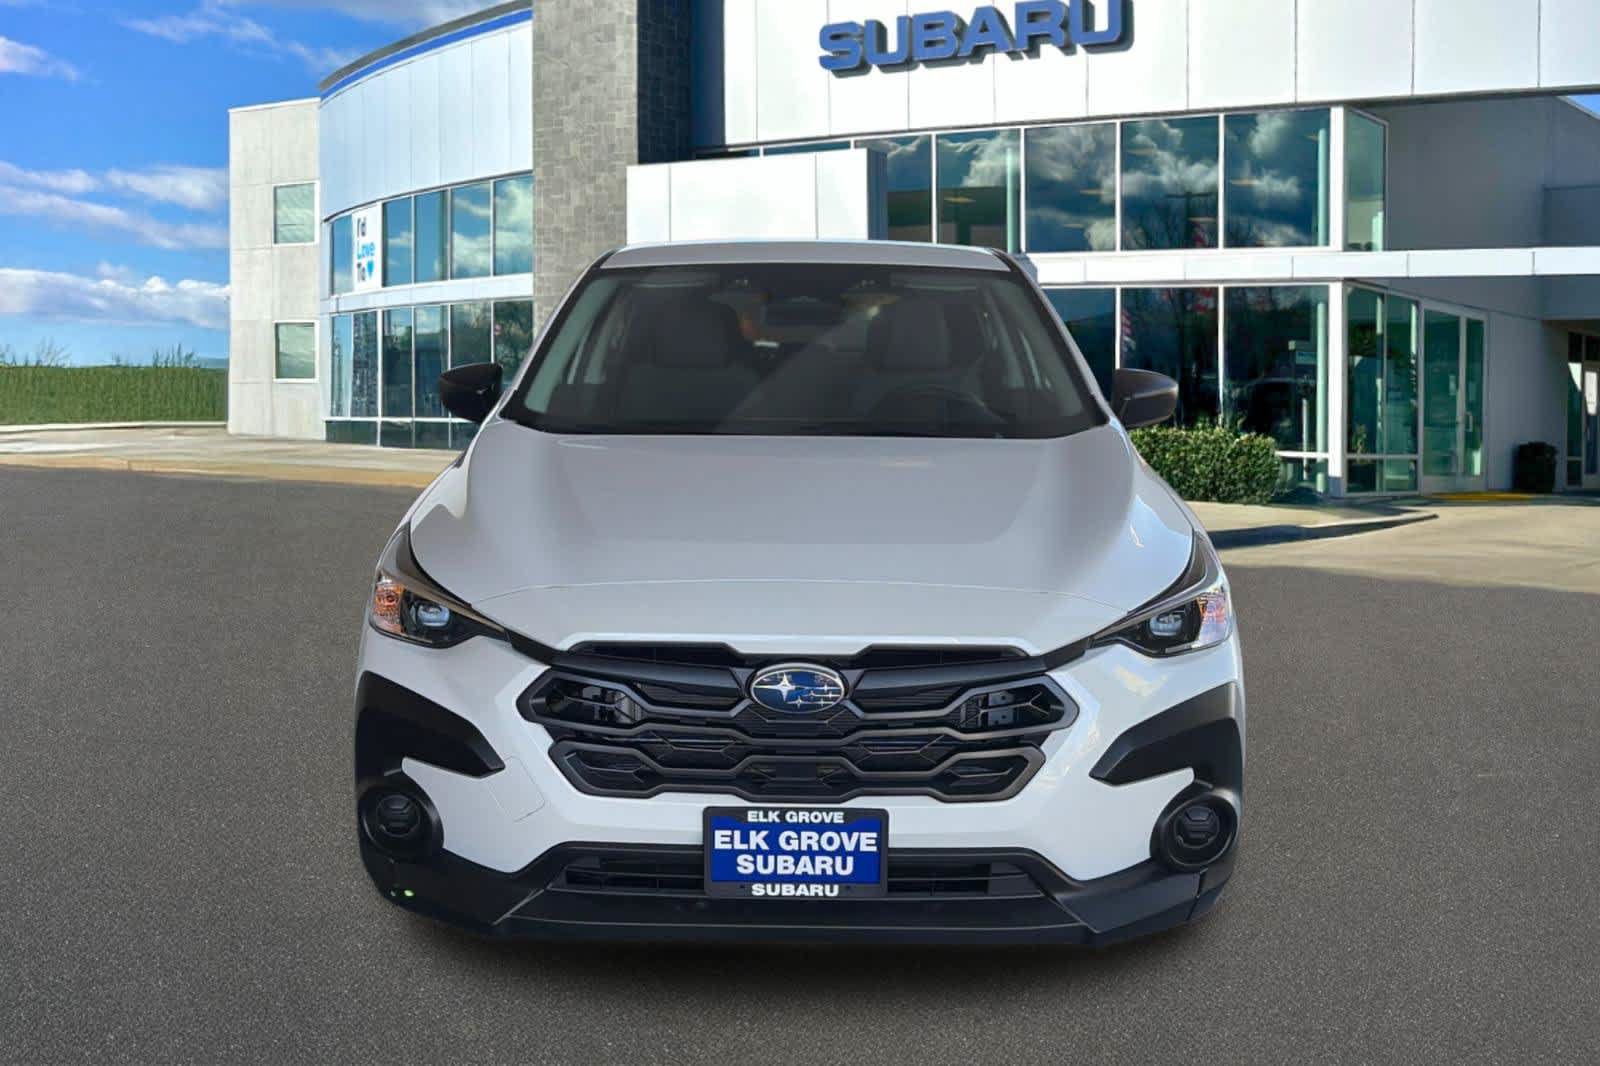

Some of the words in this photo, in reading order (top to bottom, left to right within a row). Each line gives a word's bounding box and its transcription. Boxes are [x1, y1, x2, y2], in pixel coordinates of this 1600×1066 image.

[818, 0, 1131, 75] SUBARU
[747, 810, 780, 823] ELK
[785, 811, 844, 824] GROVE
[714, 830, 770, 850] ELK
[778, 831, 878, 851] GROVE
[736, 854, 854, 875] SUBARU
[751, 883, 839, 897] SUBARU
